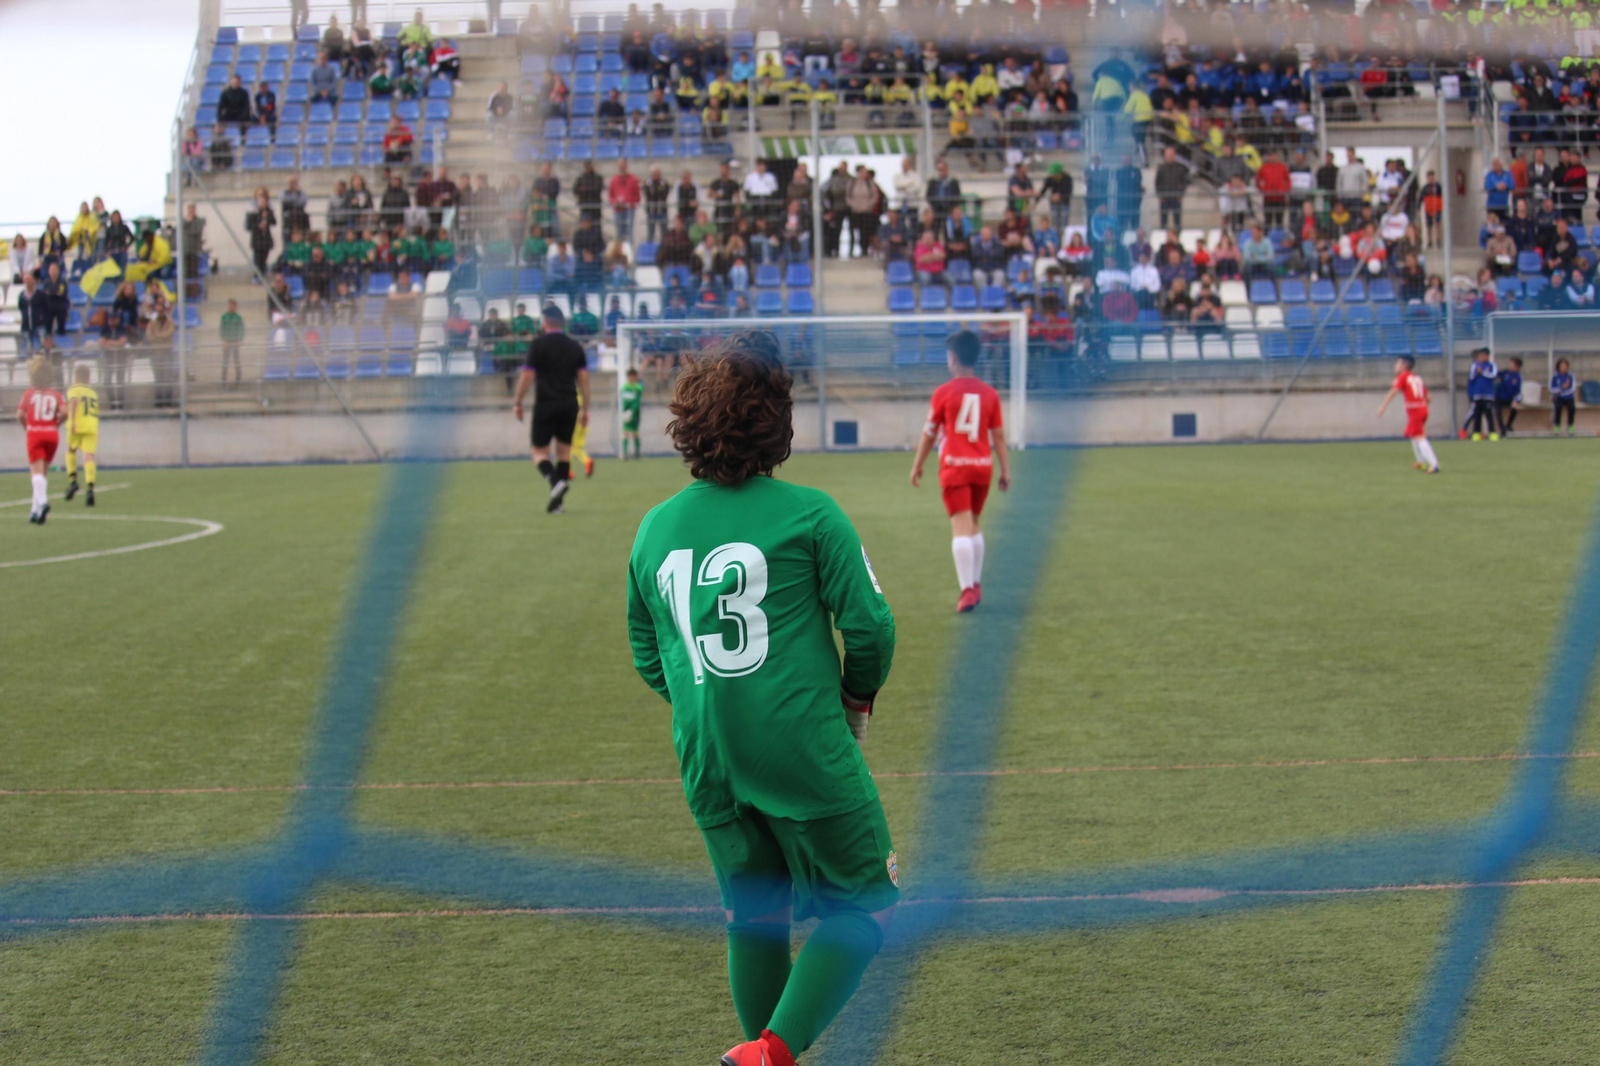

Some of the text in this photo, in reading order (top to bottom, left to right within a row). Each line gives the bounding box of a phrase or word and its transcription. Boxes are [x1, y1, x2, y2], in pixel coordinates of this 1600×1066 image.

[30, 393, 57, 421] 10
[81, 396, 99, 417] 15
[955, 393, 981, 442] 4
[656, 542, 769, 685] 13
